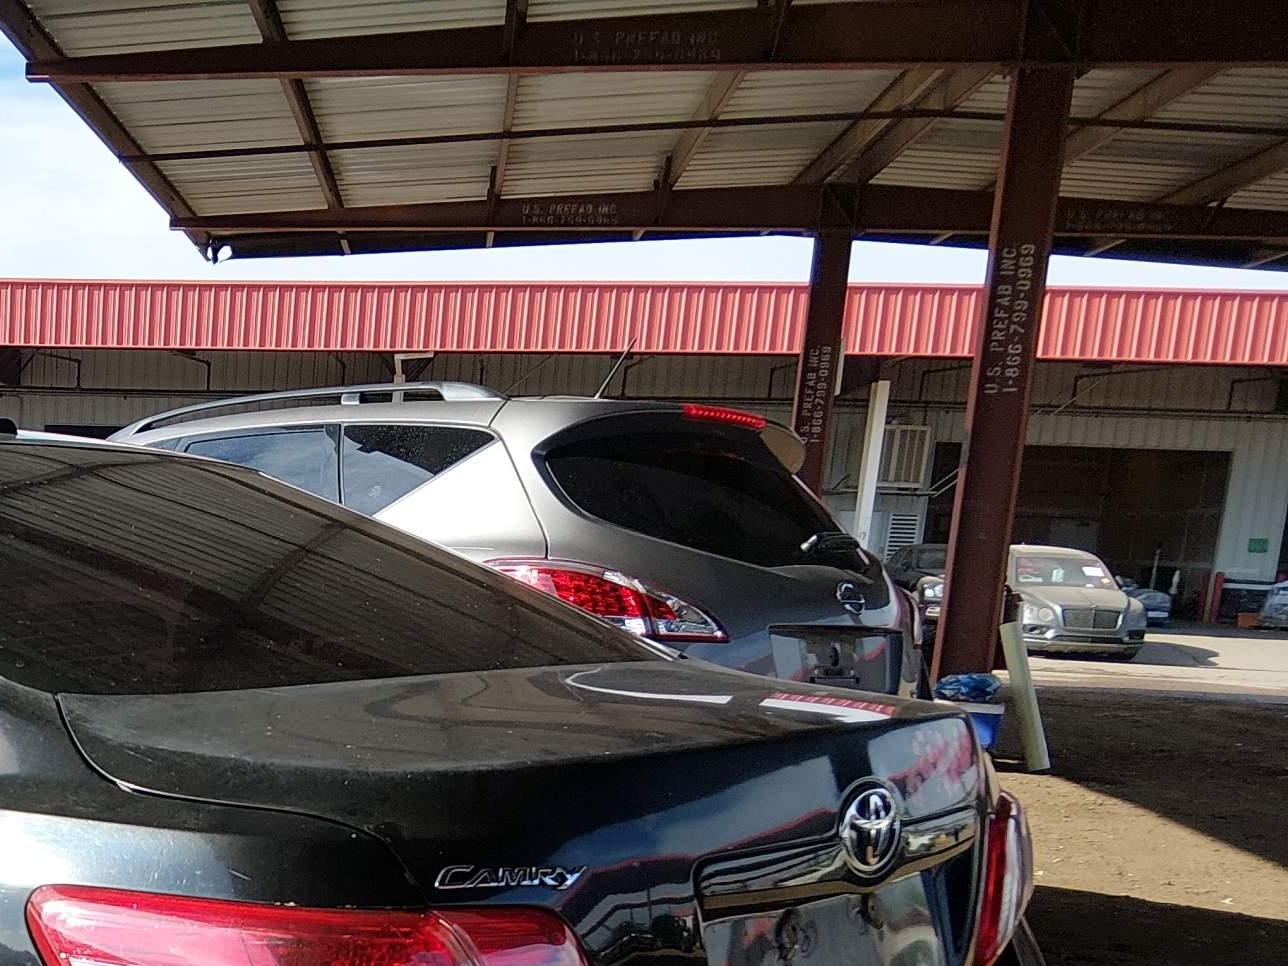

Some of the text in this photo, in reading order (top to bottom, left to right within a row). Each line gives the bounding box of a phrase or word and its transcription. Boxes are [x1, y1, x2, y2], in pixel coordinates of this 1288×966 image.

[989, 284, 1013, 352] PREFAB
[1002, 243, 1036, 393] 1-866-799-0969
[802, 372, 817, 416] PREFAB
[434, 865, 588, 889] CAMRY
